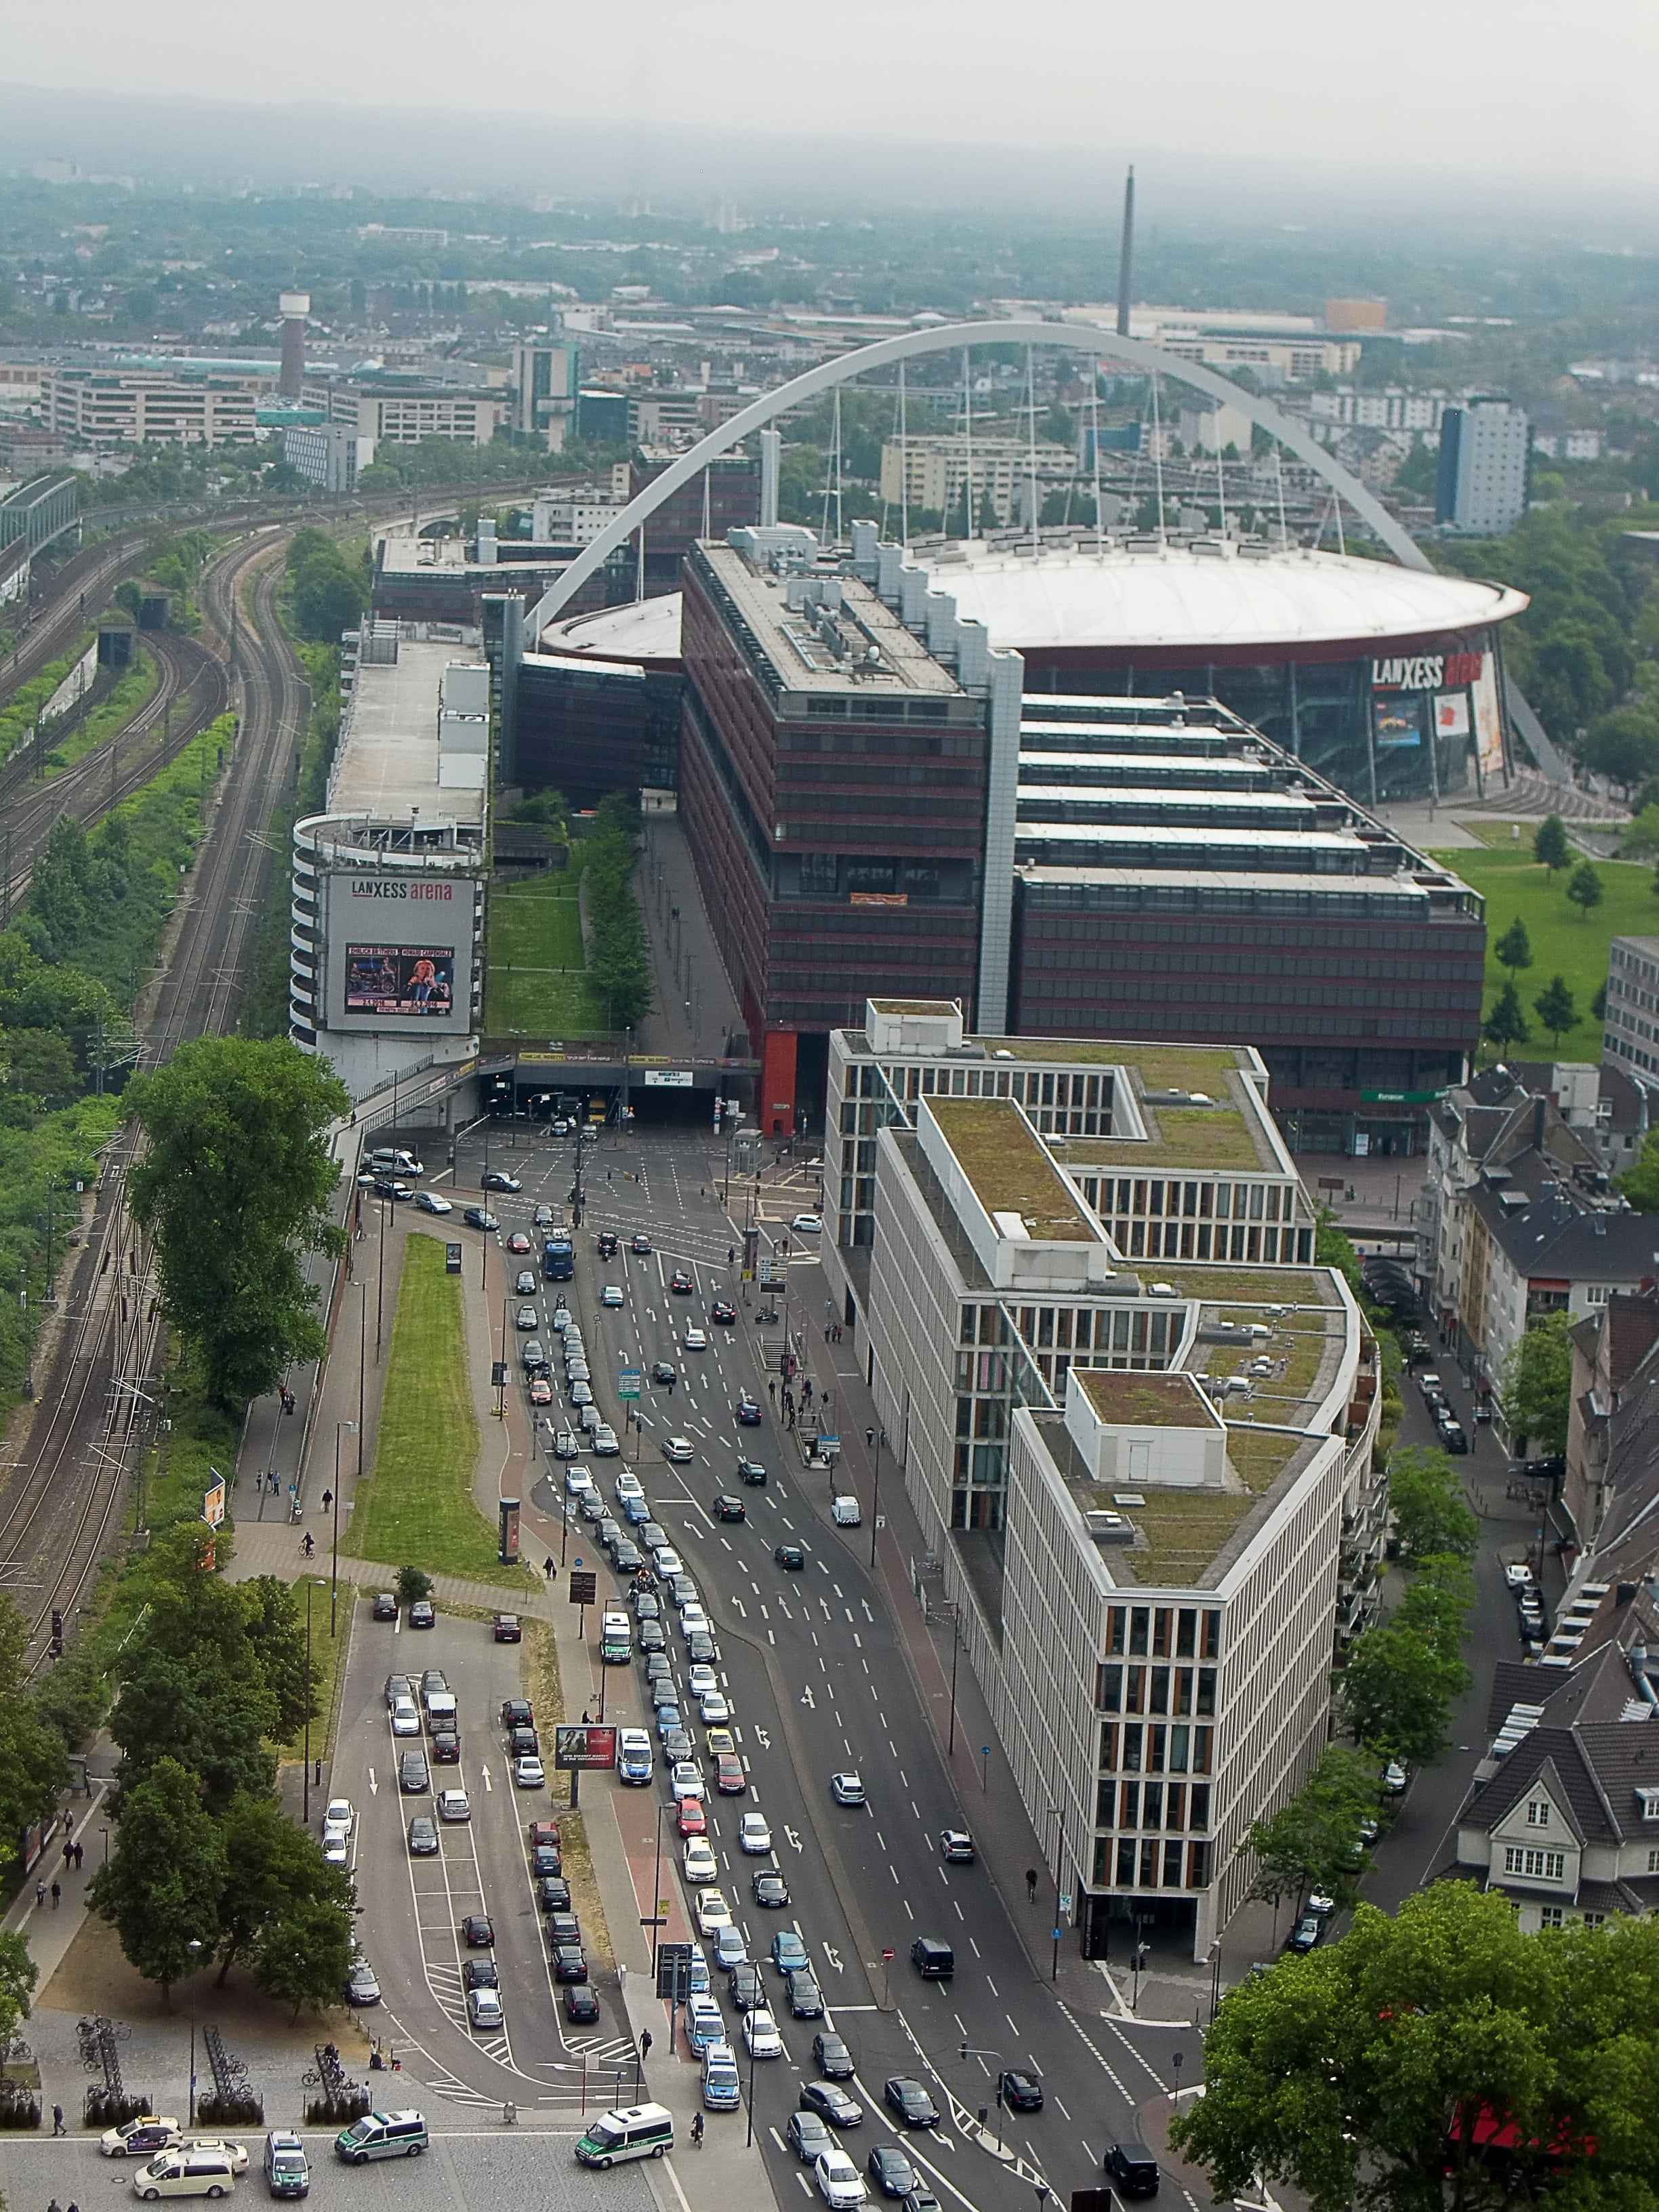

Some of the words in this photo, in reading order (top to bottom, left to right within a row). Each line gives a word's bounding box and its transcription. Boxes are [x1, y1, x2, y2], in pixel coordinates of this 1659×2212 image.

[1372, 655, 1444, 690] LANXESS
[352, 881, 407, 899] LANXESS
[410, 883, 452, 900] arena
